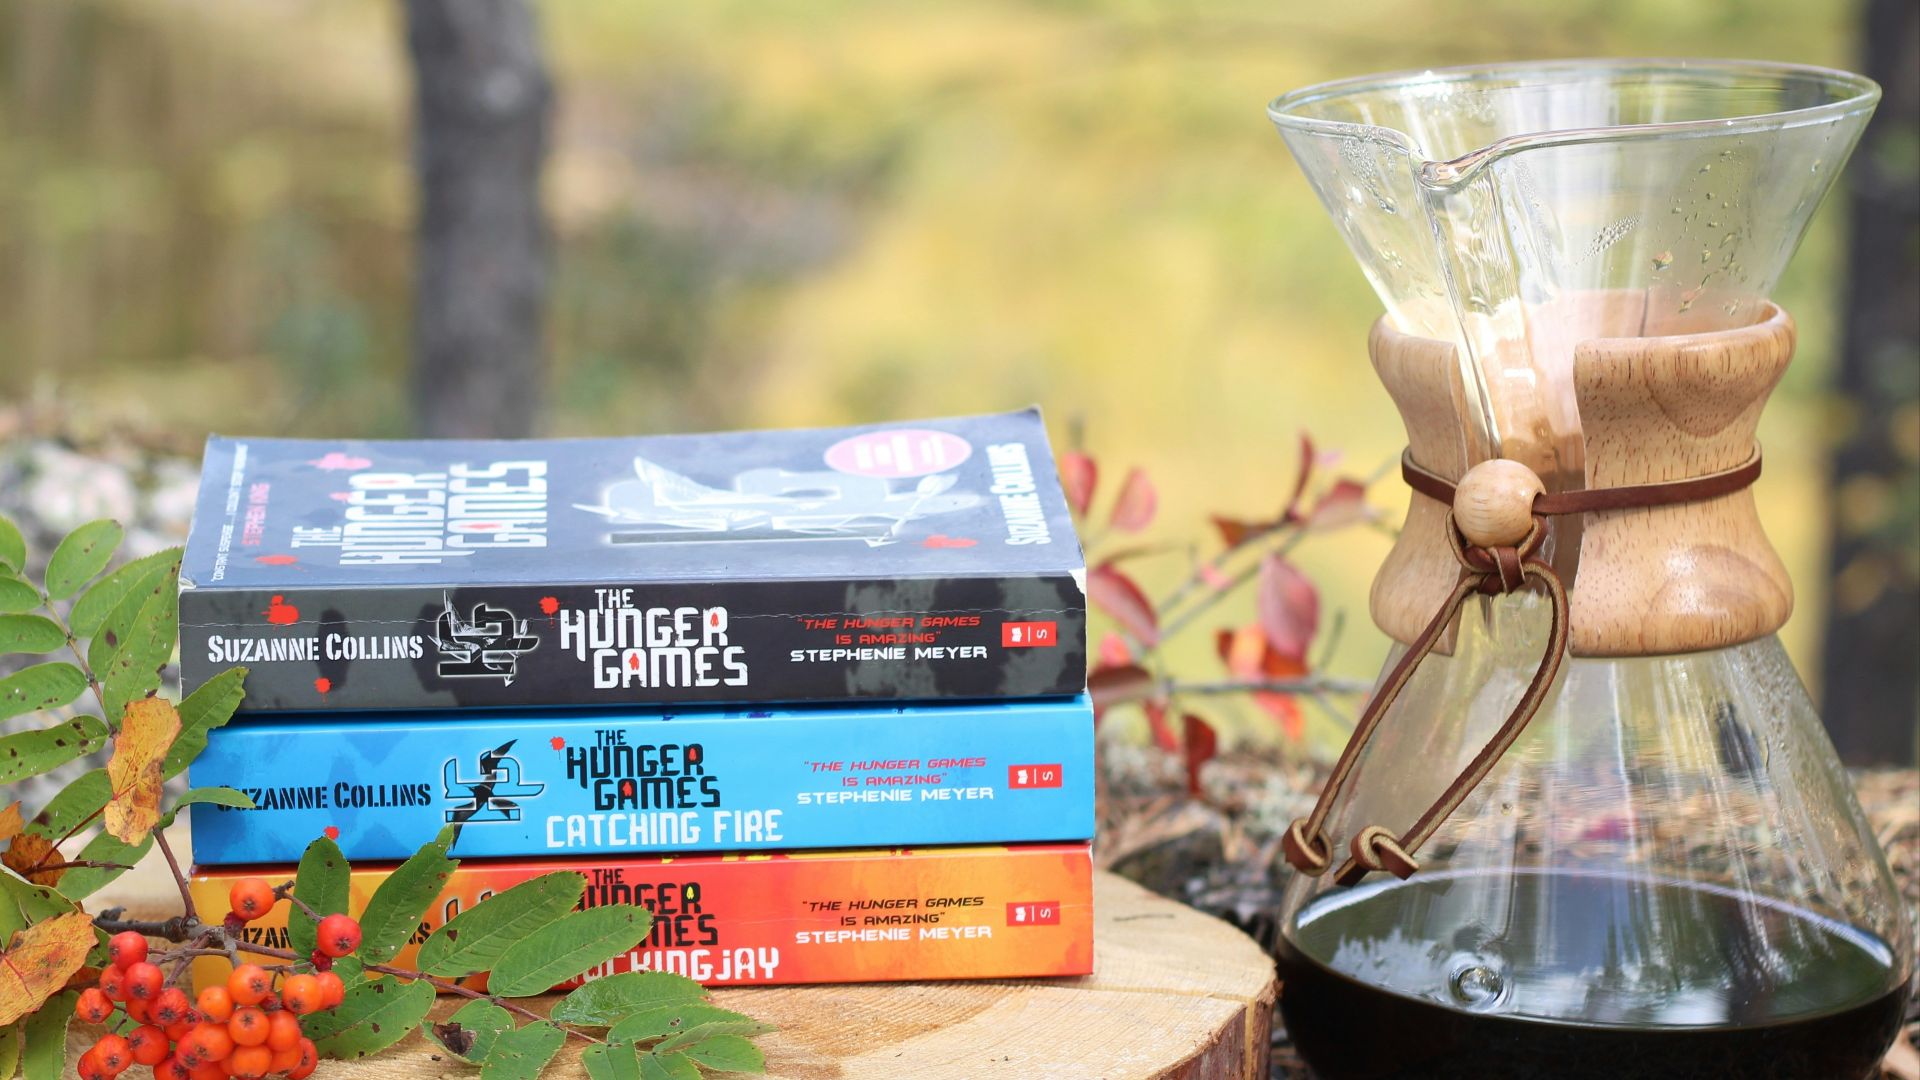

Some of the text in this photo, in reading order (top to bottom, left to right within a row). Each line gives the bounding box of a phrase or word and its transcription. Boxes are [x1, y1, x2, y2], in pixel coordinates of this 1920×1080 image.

[446, 460, 548, 547] GAMES
[986, 442, 1052, 545] SUZANNE COLLINS
[340, 473, 475, 565] HUNGER
[291, 526, 355, 548] THE
[594, 588, 635, 614] THE
[560, 606, 729, 662] HUNGER
[797, 616, 981, 630] "THE HUNGER GAMES
[208, 632, 424, 663] SUZANNE COLLINS
[835, 630, 942, 646] IS AMAZING"
[593, 645, 749, 689] GAMES
[789, 645, 988, 663] STEPHENIE MEYER
[594, 729, 627, 750] THE
[566, 743, 704, 789] HUNGER
[803, 757, 986, 773] "THE HUNGER GAMES
[593, 775, 721, 811] GAMES
[842, 772, 948, 788] IS AMAZING"
[333, 781, 432, 809] COLLINS
[796, 787, 994, 805] STEPHENIE MEYER
[546, 808, 784, 848] CATCHING FIRE
[592, 868, 624, 889] THE
[577, 882, 702, 914] UNGER
[802, 896, 985, 913] "THE HUNGER GAMES
[639, 913, 719, 948] MES
[840, 911, 946, 927] IS AMAZING"
[795, 926, 992, 945] STEPHENIE MEYER
